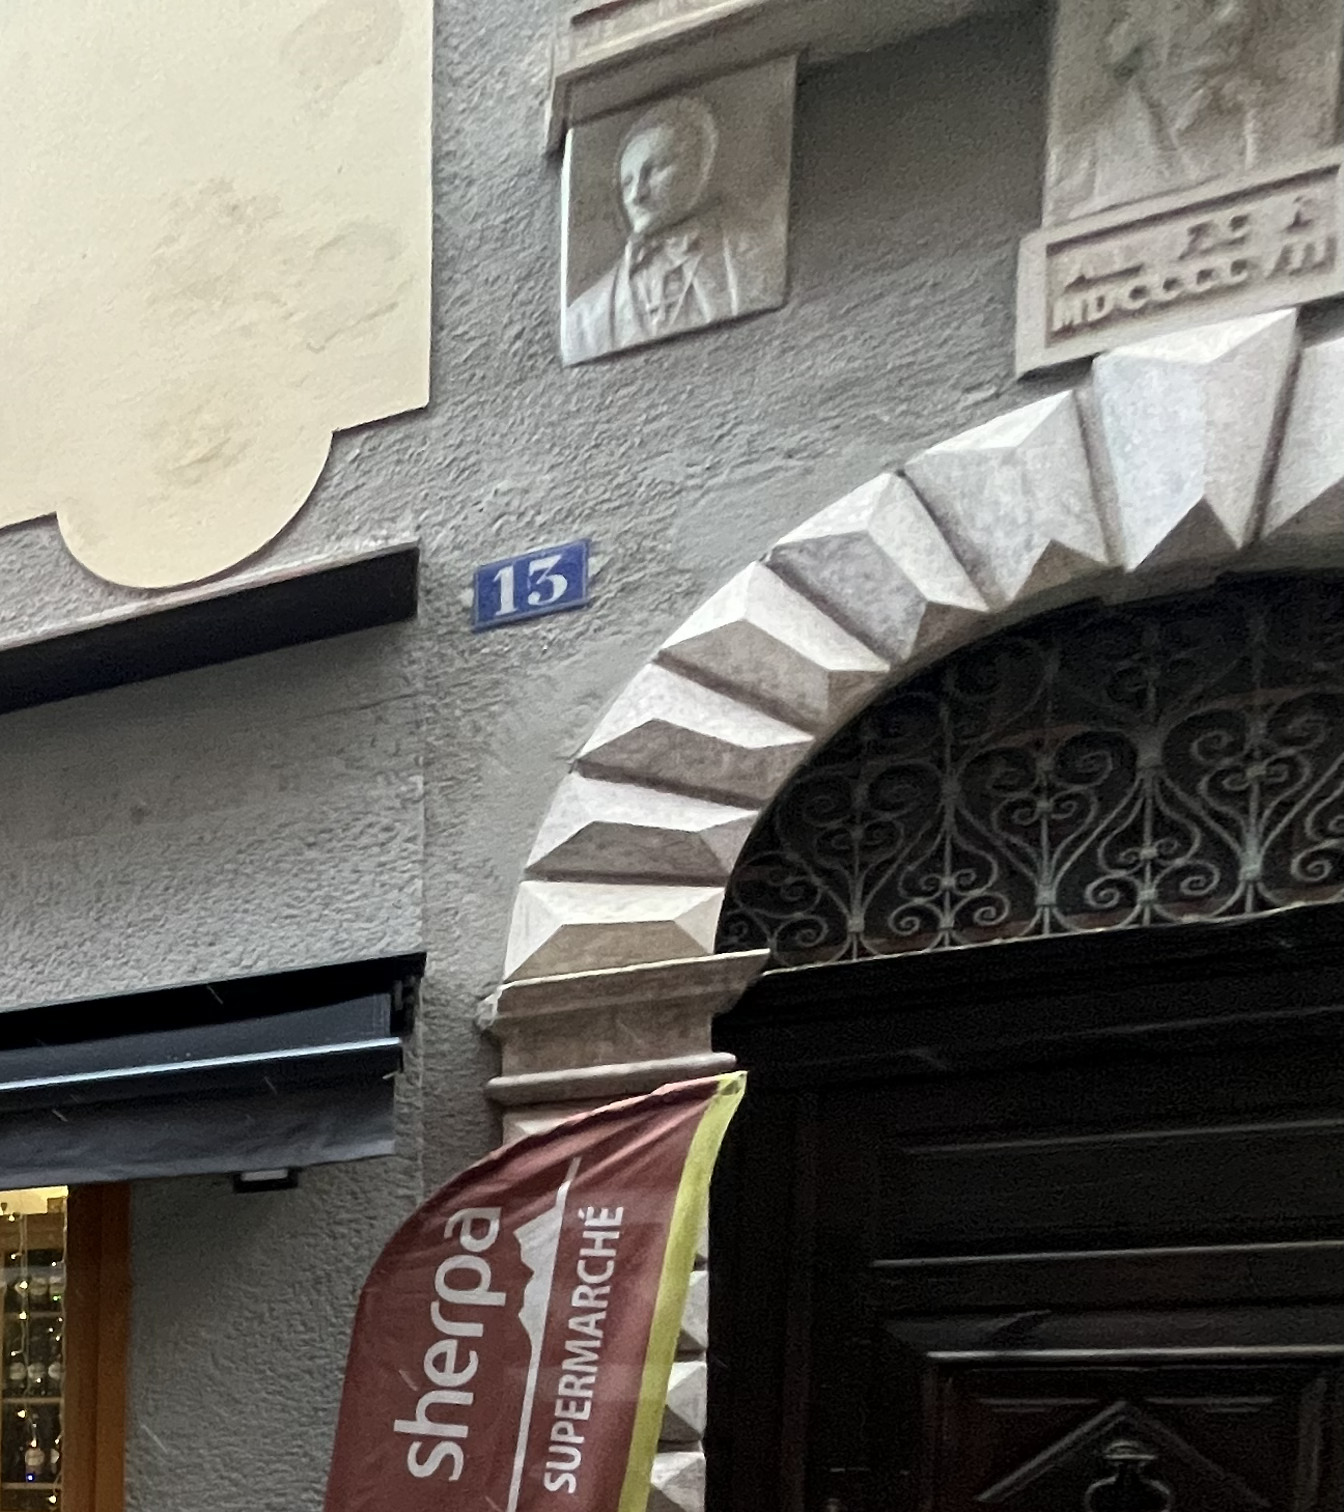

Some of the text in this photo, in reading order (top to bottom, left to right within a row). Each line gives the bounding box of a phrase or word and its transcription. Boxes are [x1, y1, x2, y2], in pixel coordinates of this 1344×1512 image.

[493, 555, 567, 616] 13
[393, 1207, 506, 1481] sherpa
[543, 1201, 624, 1494] SUPERMARCHÉ
